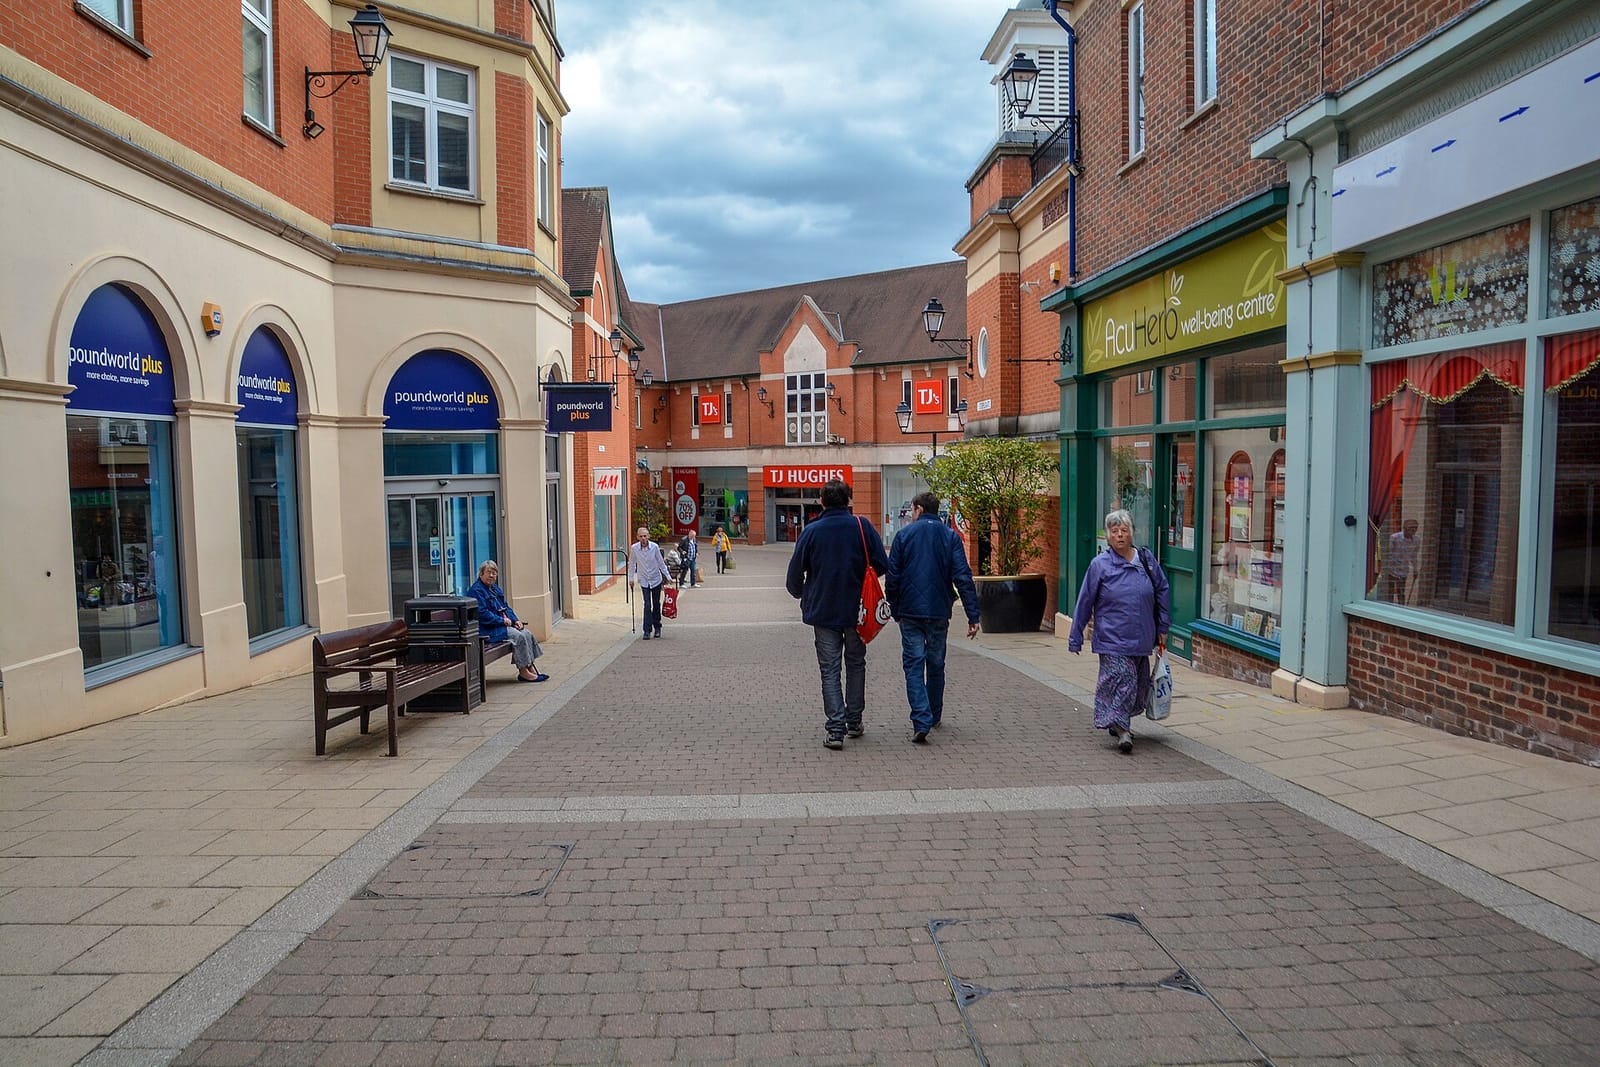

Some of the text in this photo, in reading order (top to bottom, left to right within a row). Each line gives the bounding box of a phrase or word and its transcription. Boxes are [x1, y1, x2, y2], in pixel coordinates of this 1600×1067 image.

[1181, 303, 1234, 337] well-being
[1236, 292, 1275, 321] centre
[69, 347, 163, 377] poundworld plus
[86, 371, 150, 387] more choice, more savings
[277, 377, 291, 395] plus
[395, 390, 489, 406] poundworld plus
[917, 388, 940, 405] TJ's
[556, 401, 604, 412] poundworld
[702, 402, 719, 417] TJ's
[570, 411, 590, 421] plus
[770, 469, 844, 483] TJ HUGHES
[679, 503, 693, 512] 70%
[679, 511, 693, 521] OFF
